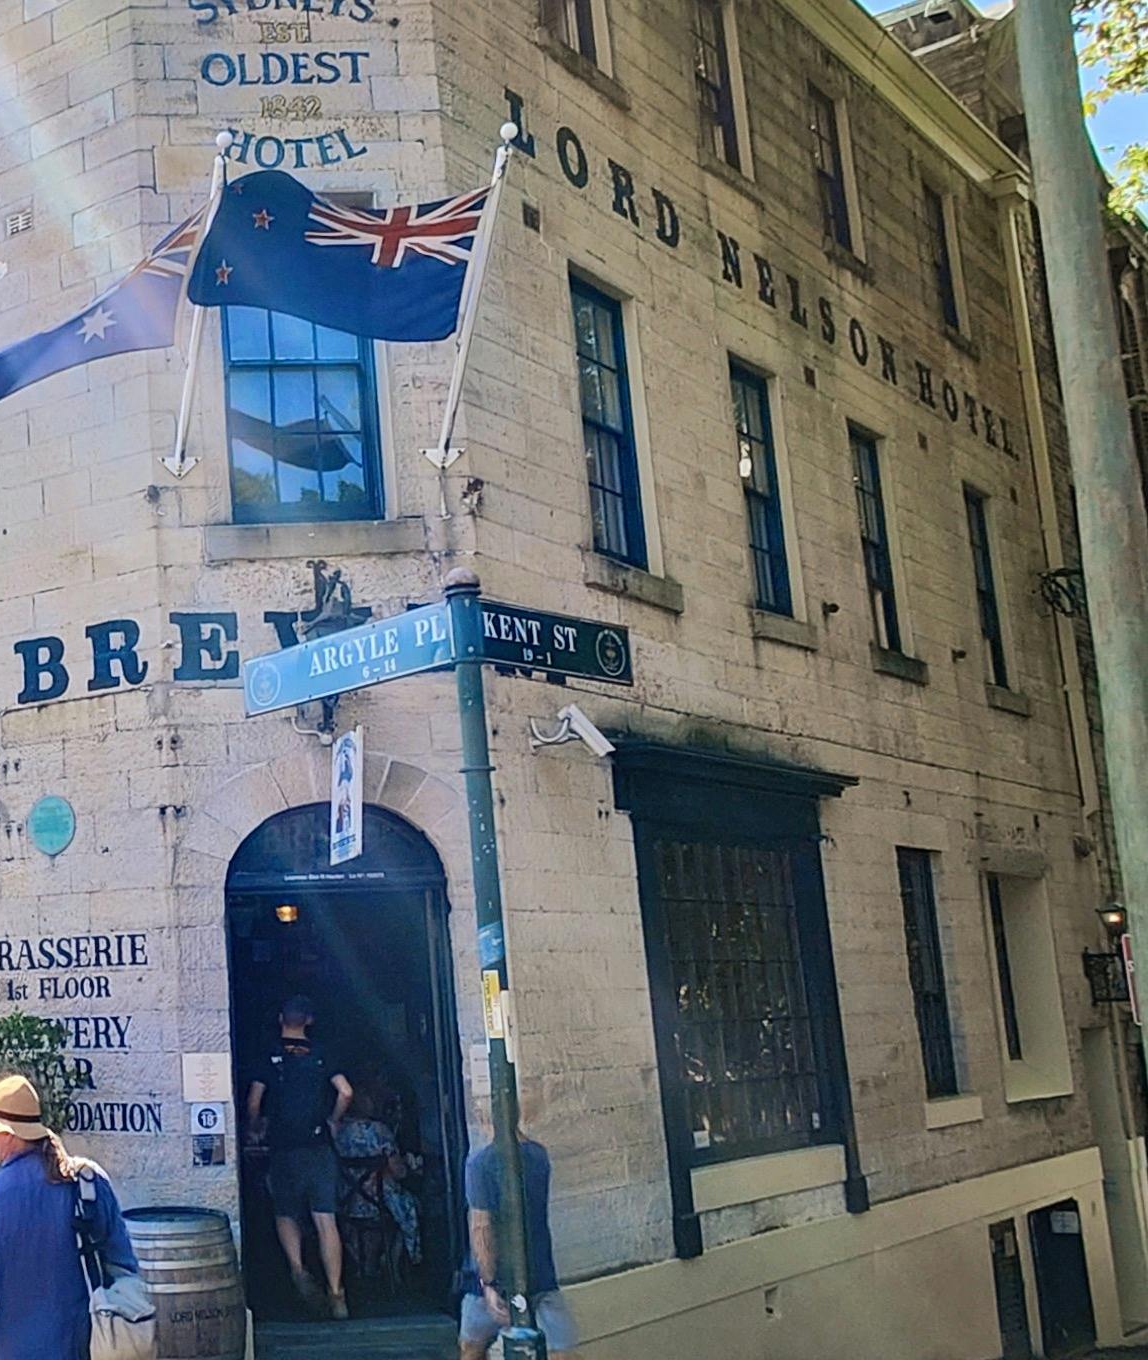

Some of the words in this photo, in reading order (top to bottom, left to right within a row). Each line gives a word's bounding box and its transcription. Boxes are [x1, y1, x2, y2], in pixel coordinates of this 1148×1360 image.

[201, 51, 370, 86] OLDEST
[259, 95, 324, 119] 1842
[223, 127, 367, 169] HOTEL
[503, 86, 681, 248] LORD
[717, 229, 898, 385] NELSON
[308, 627, 399, 678] ARGYLE
[414, 615, 447, 647] PL
[481, 610, 541, 646] KENT
[553, 624, 578, 652] ST
[7, 979, 28, 1001] 1st
[38, 976, 112, 1000] FLOOR
[200, 1113, 214, 1127] 18
